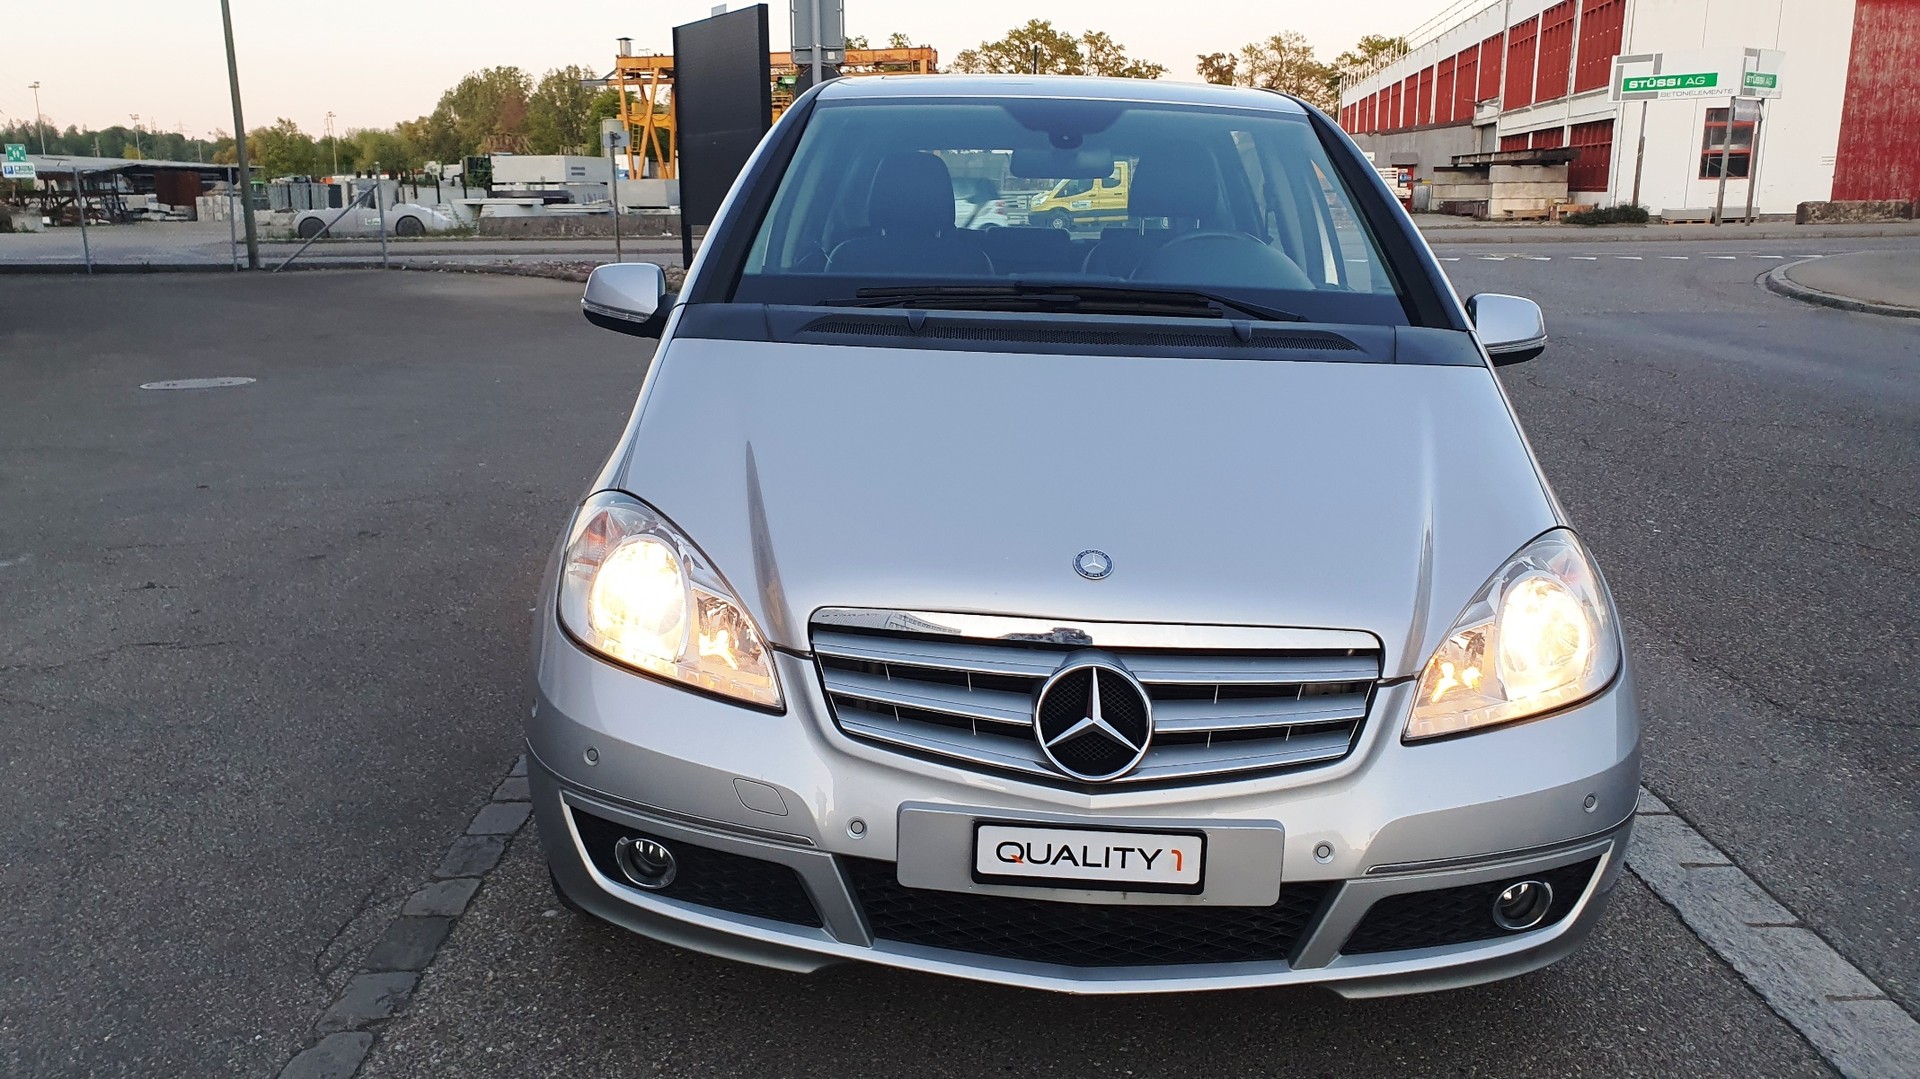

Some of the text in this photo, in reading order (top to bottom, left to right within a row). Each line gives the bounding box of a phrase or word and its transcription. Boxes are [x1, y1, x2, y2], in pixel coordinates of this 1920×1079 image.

[1628, 76, 1706, 89] STÜSSI AG
[1660, 88, 1734, 98] BETONELEMENTE
[995, 841, 1183, 872] QUALITY 1
